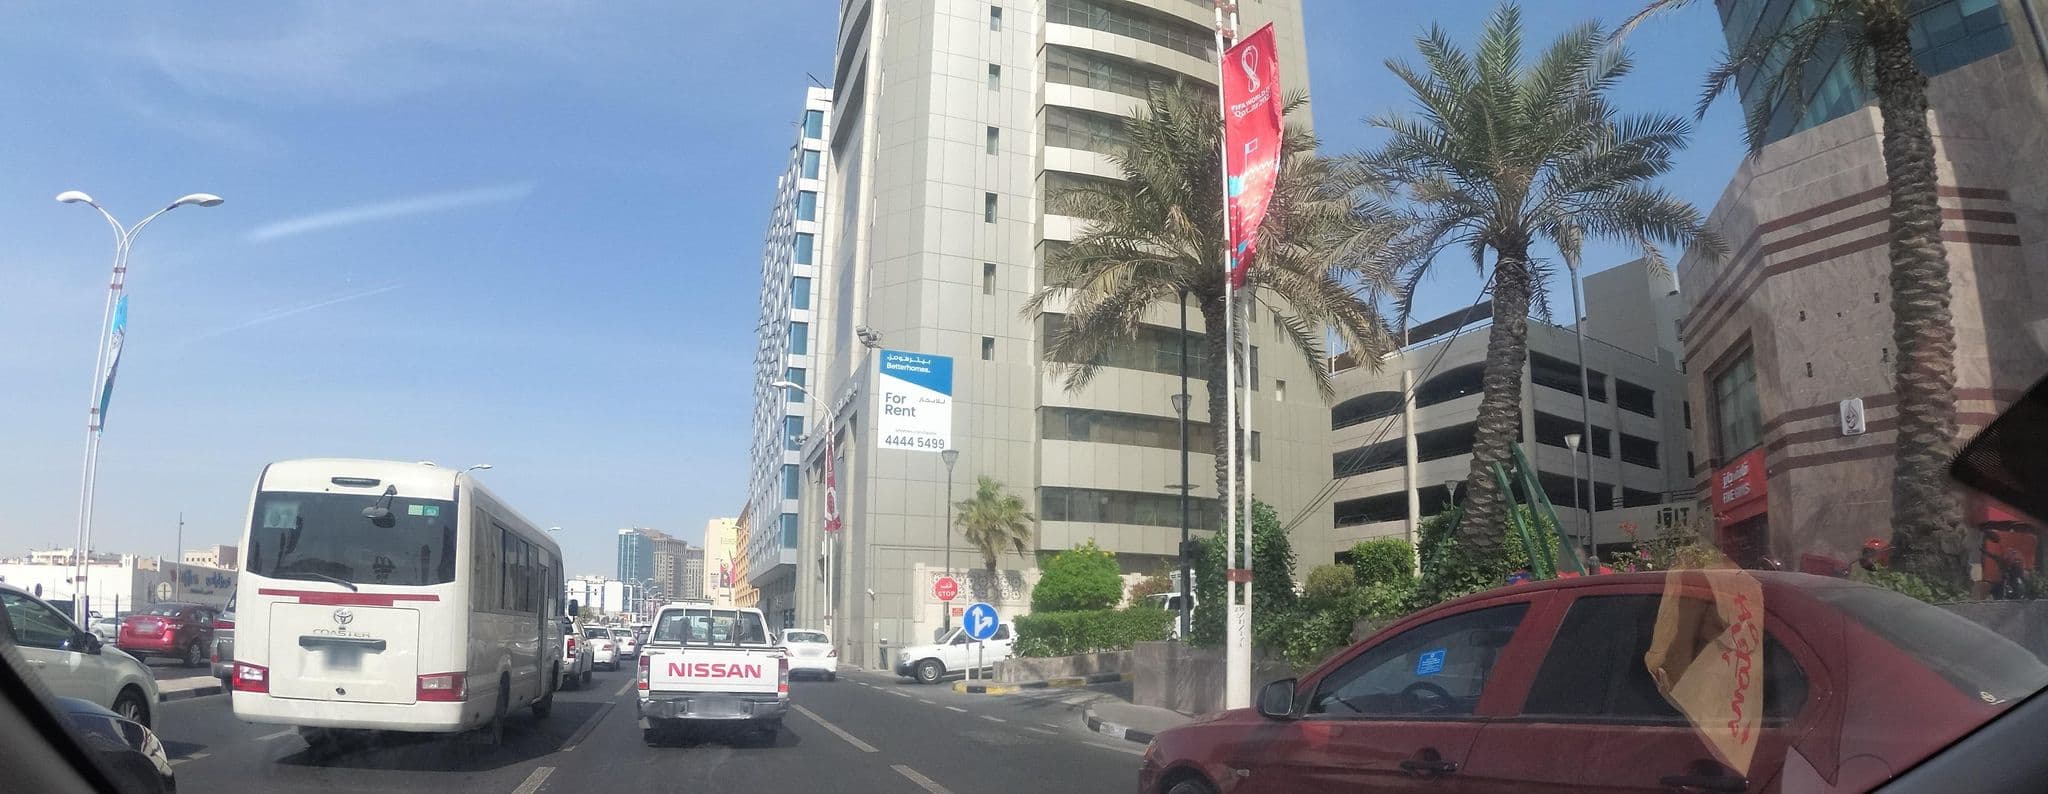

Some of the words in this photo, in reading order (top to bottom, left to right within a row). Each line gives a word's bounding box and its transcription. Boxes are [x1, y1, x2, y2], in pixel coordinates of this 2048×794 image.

[885, 392, 907, 404] For
[885, 404, 916, 417] Rent
[885, 435, 915, 448] 4444
[917, 437, 945, 449] 5499
[313, 629, 370, 638] COASTER
[668, 662, 762, 679] NISSAN
